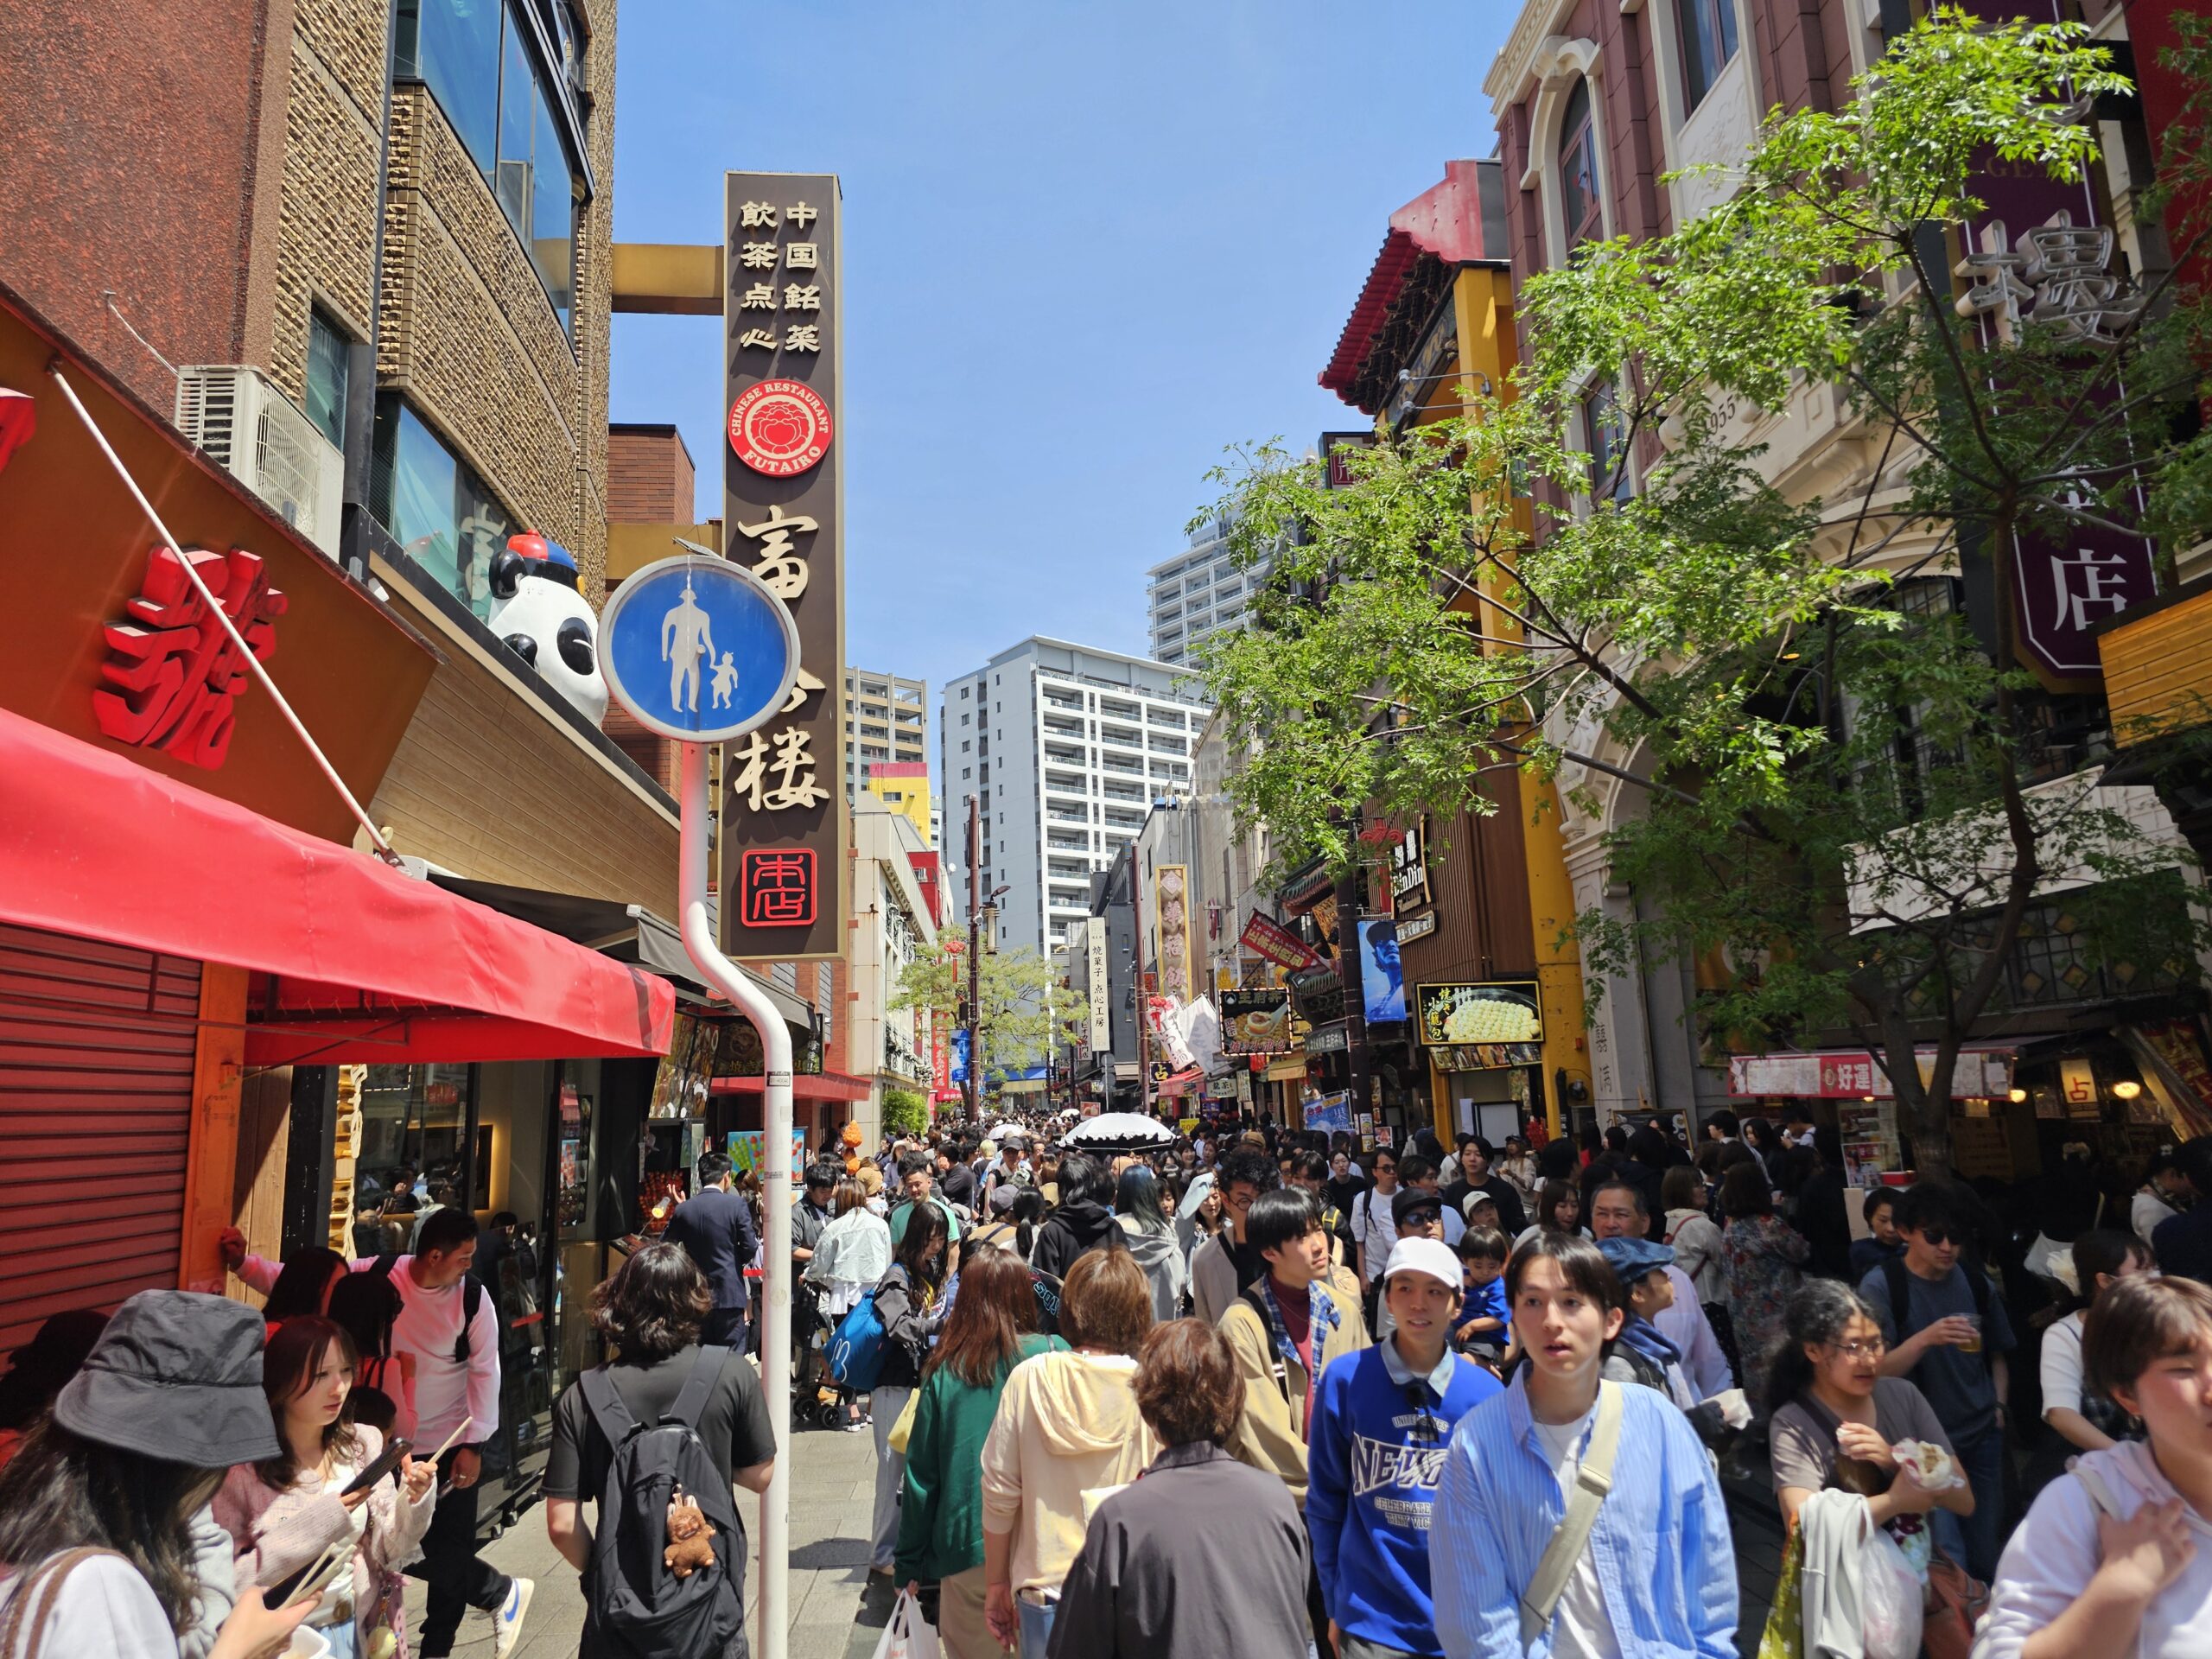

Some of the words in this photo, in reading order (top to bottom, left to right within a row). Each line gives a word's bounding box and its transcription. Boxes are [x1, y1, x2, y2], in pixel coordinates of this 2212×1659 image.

[740, 200, 778, 352] 飲茶点心
[785, 200, 821, 353] 中国銘菜
[731, 385, 764, 436] CHINESE
[764, 382, 829, 435] RESTAURANT
[743, 445, 822, 474] FUTAIRO
[1092, 945, 1106, 1027] 焼菓子・点心工房
[1838, 1064, 1870, 1090] 好運
[2069, 1077, 2090, 1109] 占
[1392, 1414, 1421, 1427] UNITE
[1375, 1497, 1432, 1515] CELEBRATE
